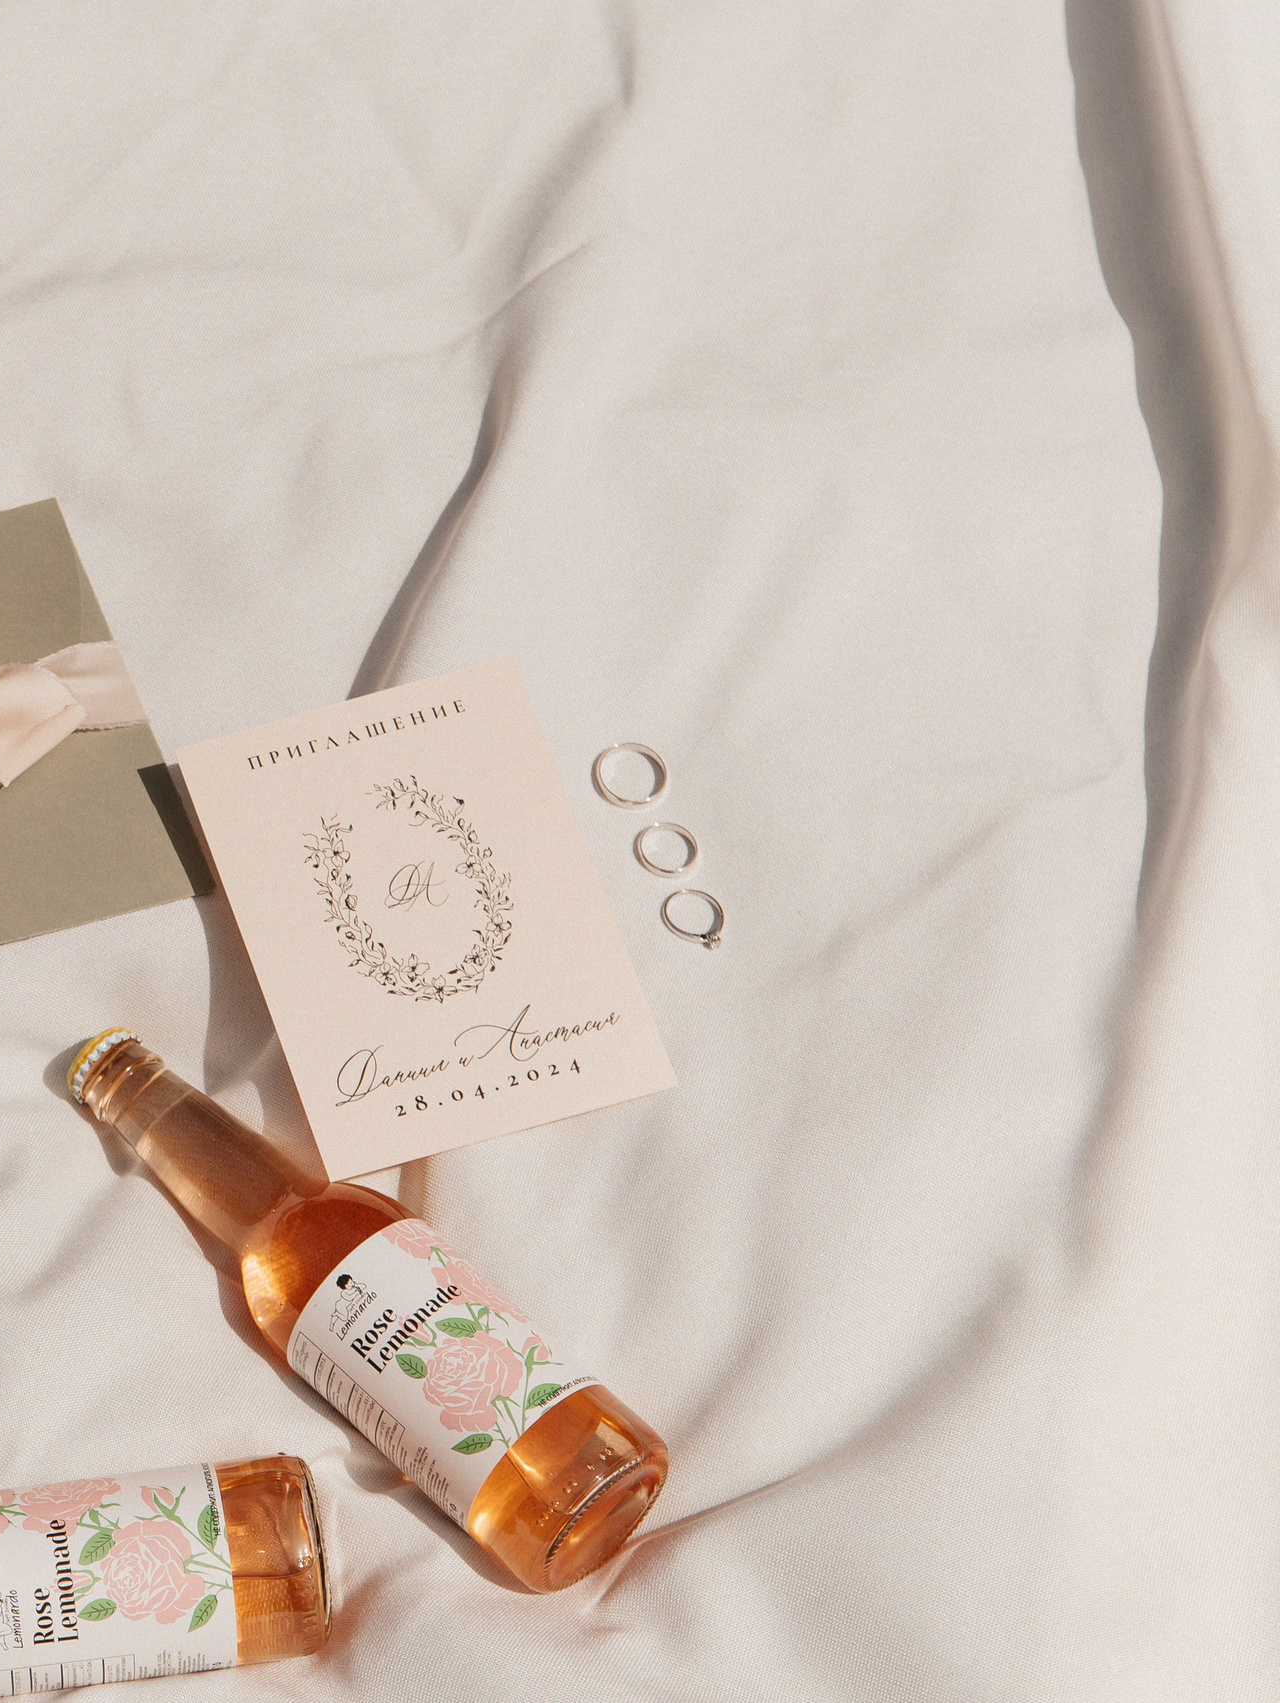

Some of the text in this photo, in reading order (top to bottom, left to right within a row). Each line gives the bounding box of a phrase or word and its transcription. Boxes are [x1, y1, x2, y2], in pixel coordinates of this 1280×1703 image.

[247, 699, 468, 770] ПРИГЛАШЕНИЕ
[335, 1004, 621, 1106] Даниил и Анастасия
[394, 1057, 584, 1117] 28.04.2024
[336, 1290, 378, 1341] Lemonardo
[349, 1305, 398, 1361] Rose
[365, 1283, 462, 1375] Lemonade
[46, 1518, 79, 1642] Lemonade
[12, 1588, 24, 1649] Lemonardo
[33, 1587, 55, 1646] Rose
